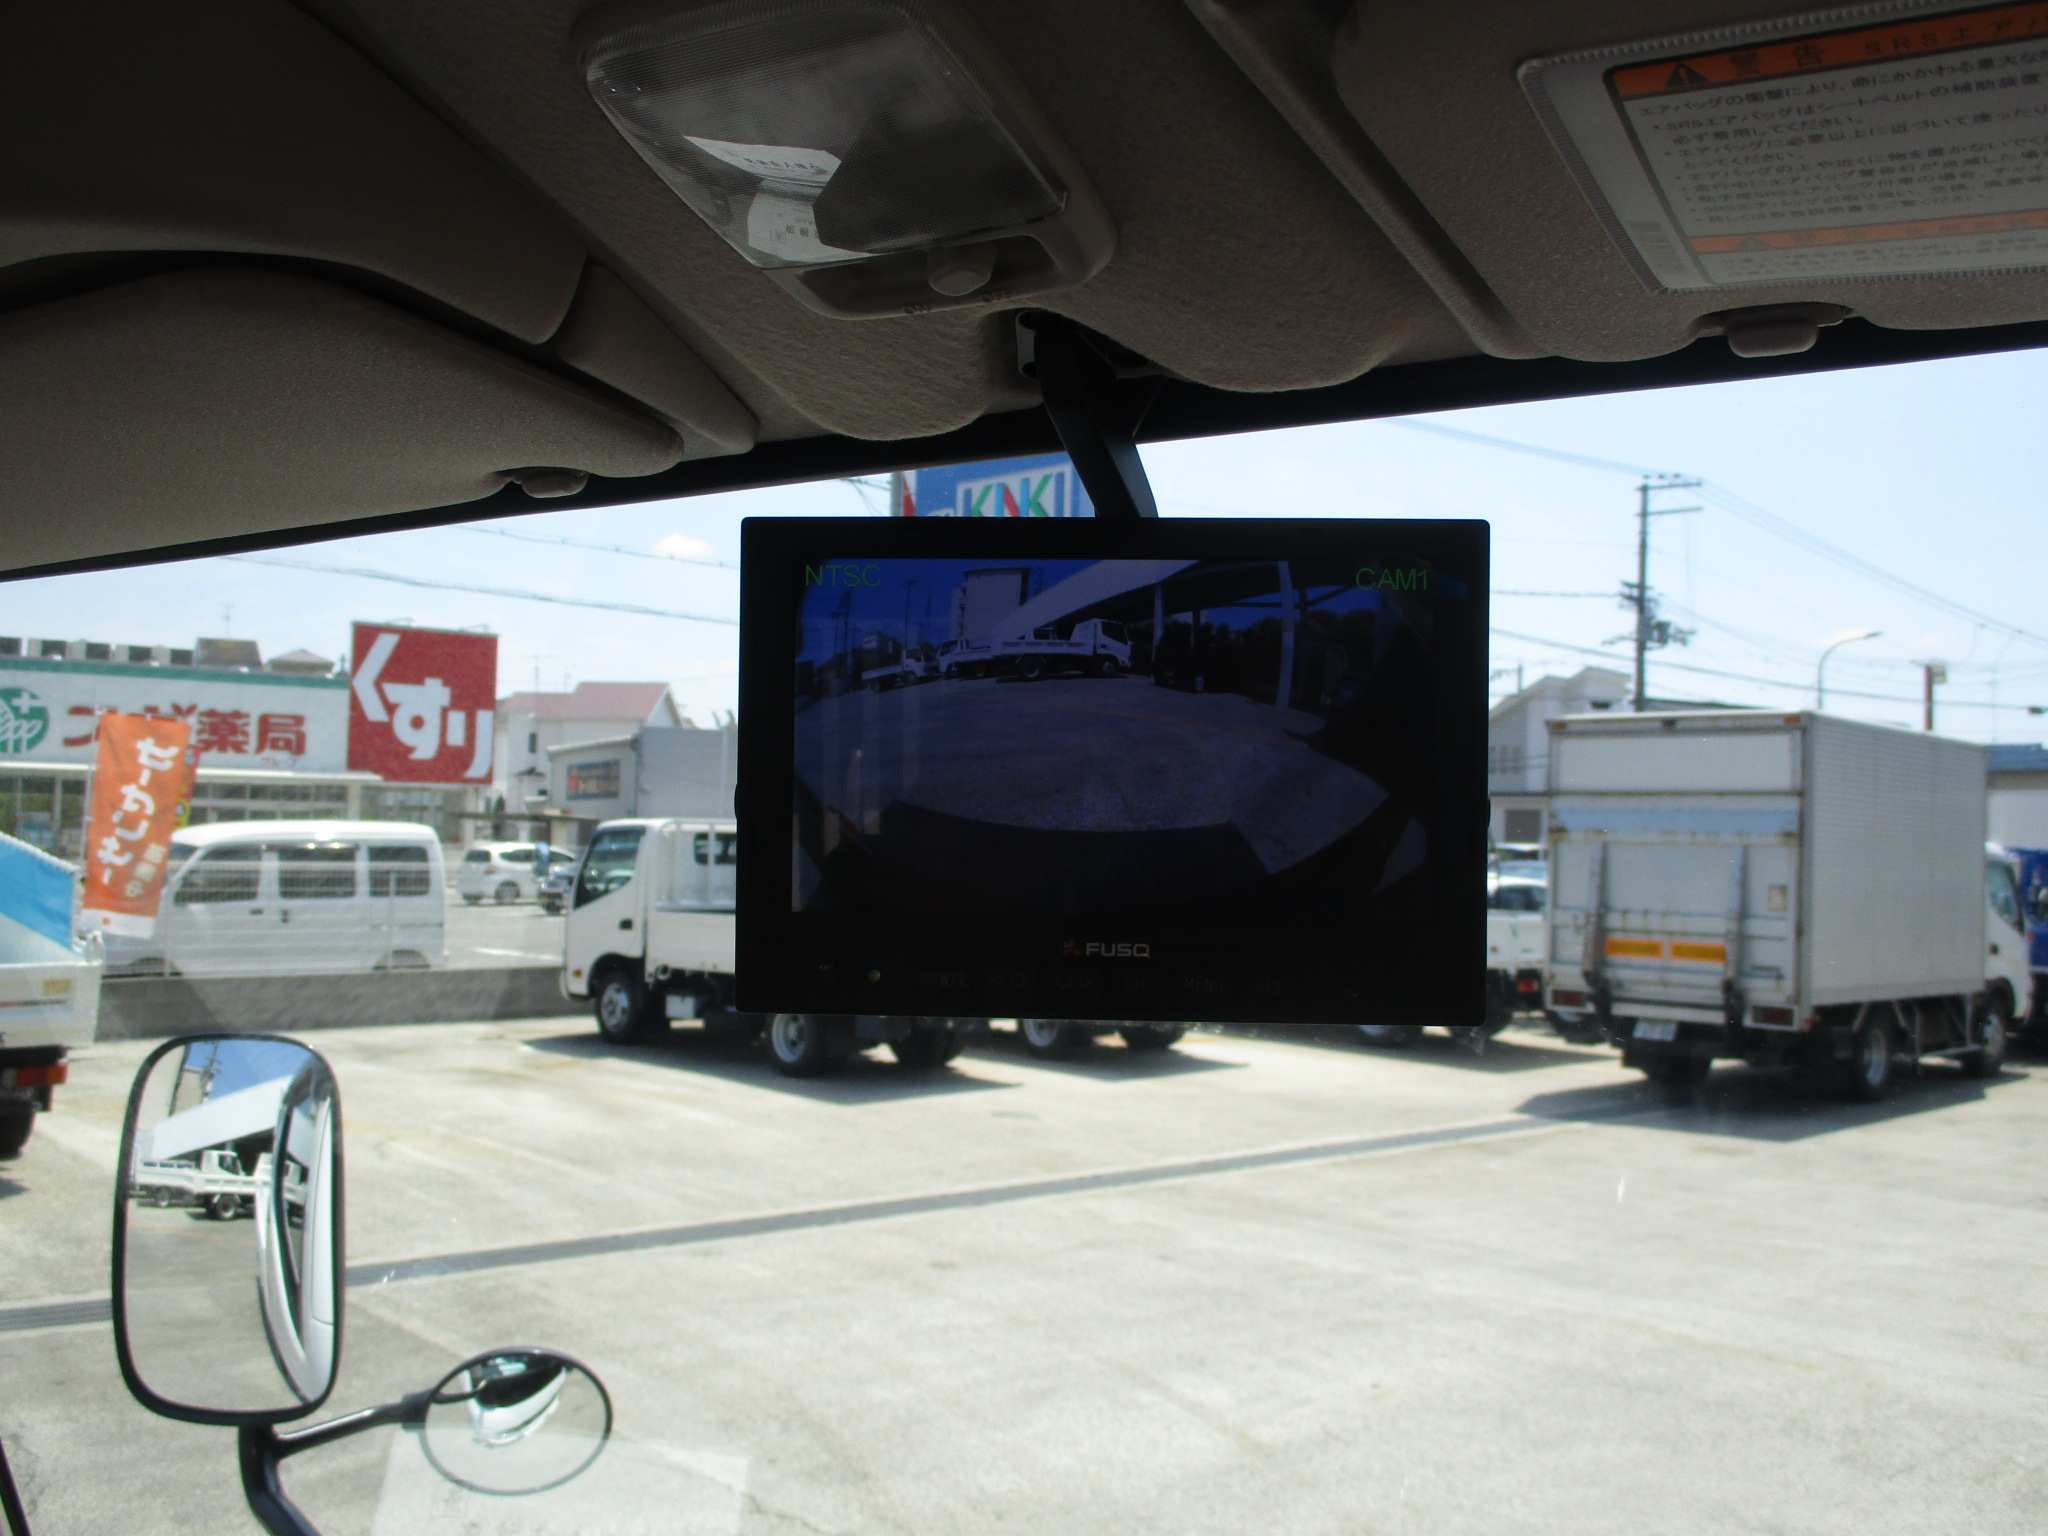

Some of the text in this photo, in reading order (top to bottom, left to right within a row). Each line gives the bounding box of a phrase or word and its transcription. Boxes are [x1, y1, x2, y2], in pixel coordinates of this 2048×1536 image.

[804, 564, 882, 588] NTSC
[1355, 566, 1431, 592] CAM1
[352, 632, 494, 779] くすり
[1085, 941, 1151, 959] FUSQ
